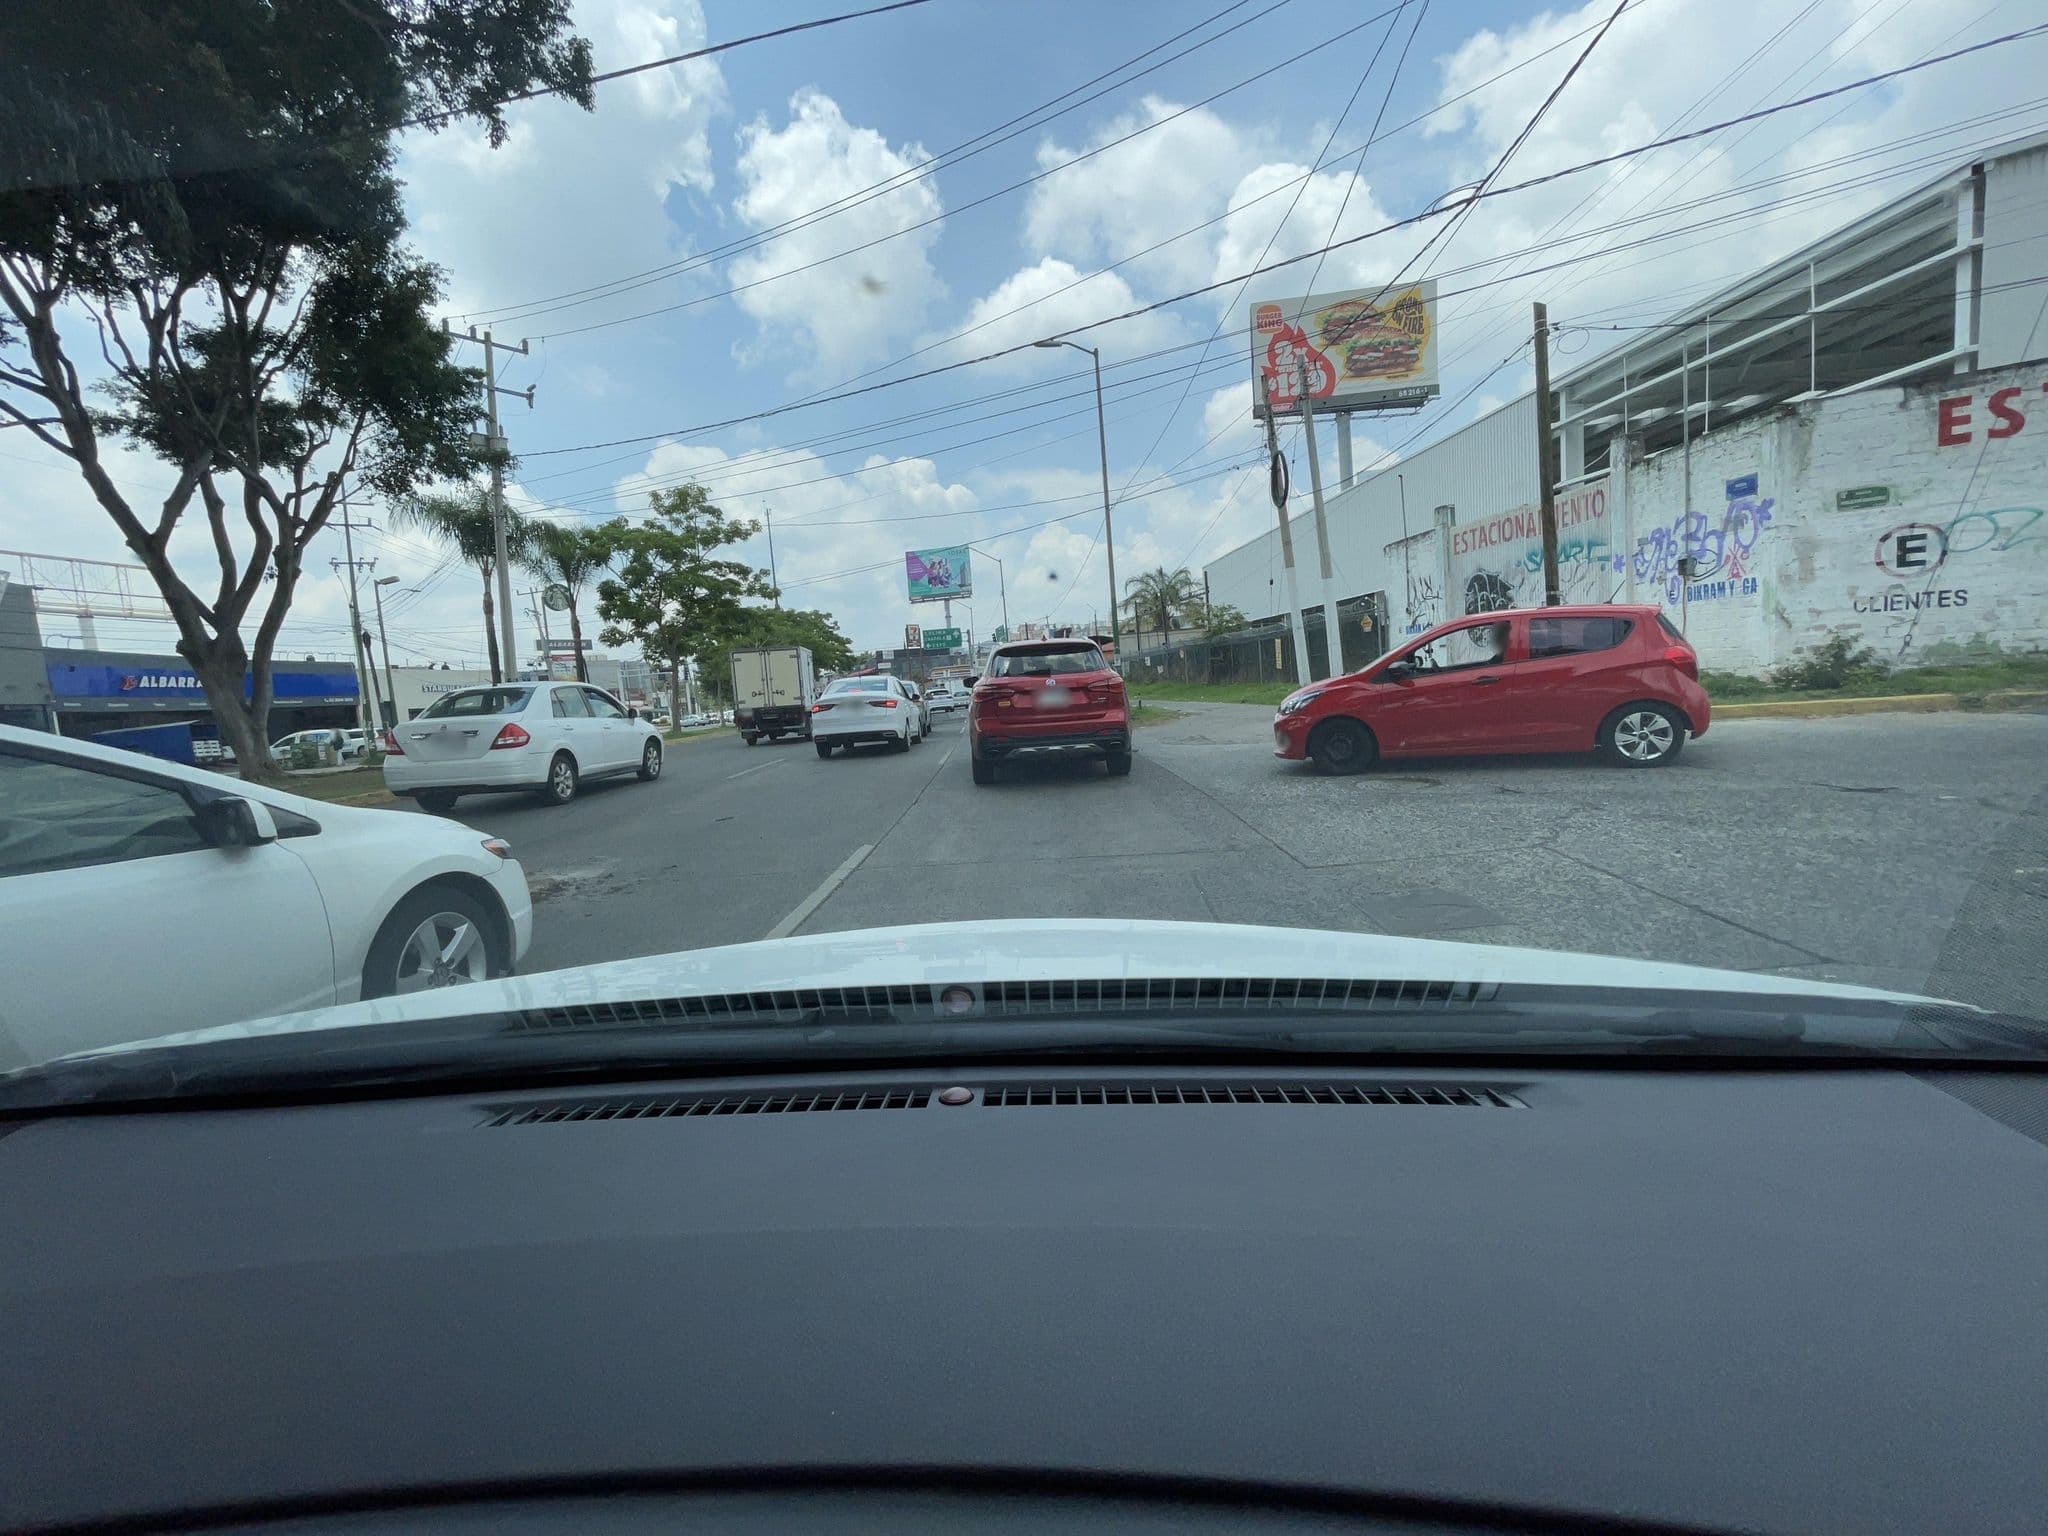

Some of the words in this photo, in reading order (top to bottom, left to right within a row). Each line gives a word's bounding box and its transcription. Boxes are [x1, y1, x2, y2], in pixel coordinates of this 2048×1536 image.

[1257, 319, 1283, 329] KING
[1403, 316, 1424, 334] FIRE
[1939, 382, 2048, 447] ES
[1453, 489, 1605, 555] ESTACIONAIENTO
[1896, 533, 1927, 568] E
[1687, 581, 1726, 602] BIKRAM
[1853, 589, 1968, 614] CLIENTES
